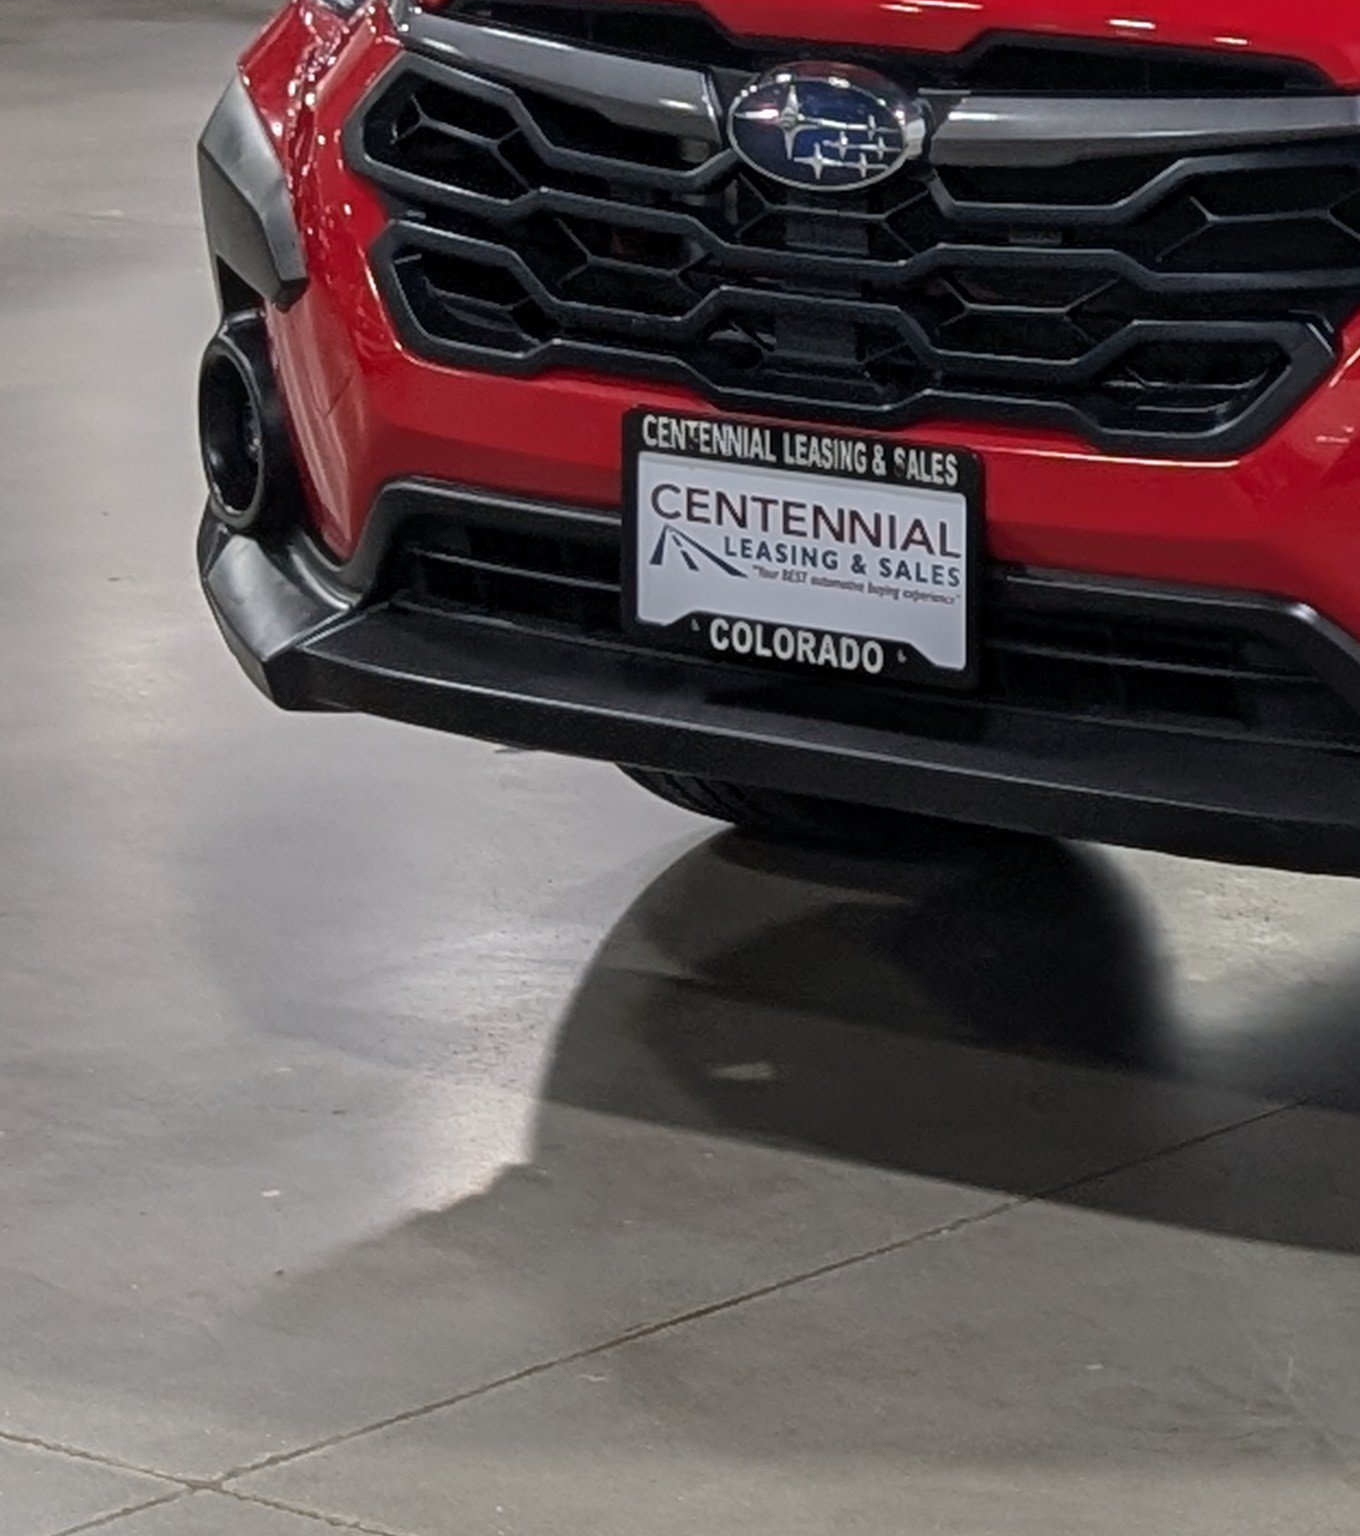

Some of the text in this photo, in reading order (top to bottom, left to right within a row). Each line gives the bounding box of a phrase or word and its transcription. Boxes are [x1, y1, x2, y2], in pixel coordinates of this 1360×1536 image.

[642, 414, 958, 486] CENTENNIAL LEASING & SALES
[651, 483, 962, 559] CENTENNIAL
[724, 536, 961, 588] LEASING & SALES
[710, 618, 884, 674] COLORADO
